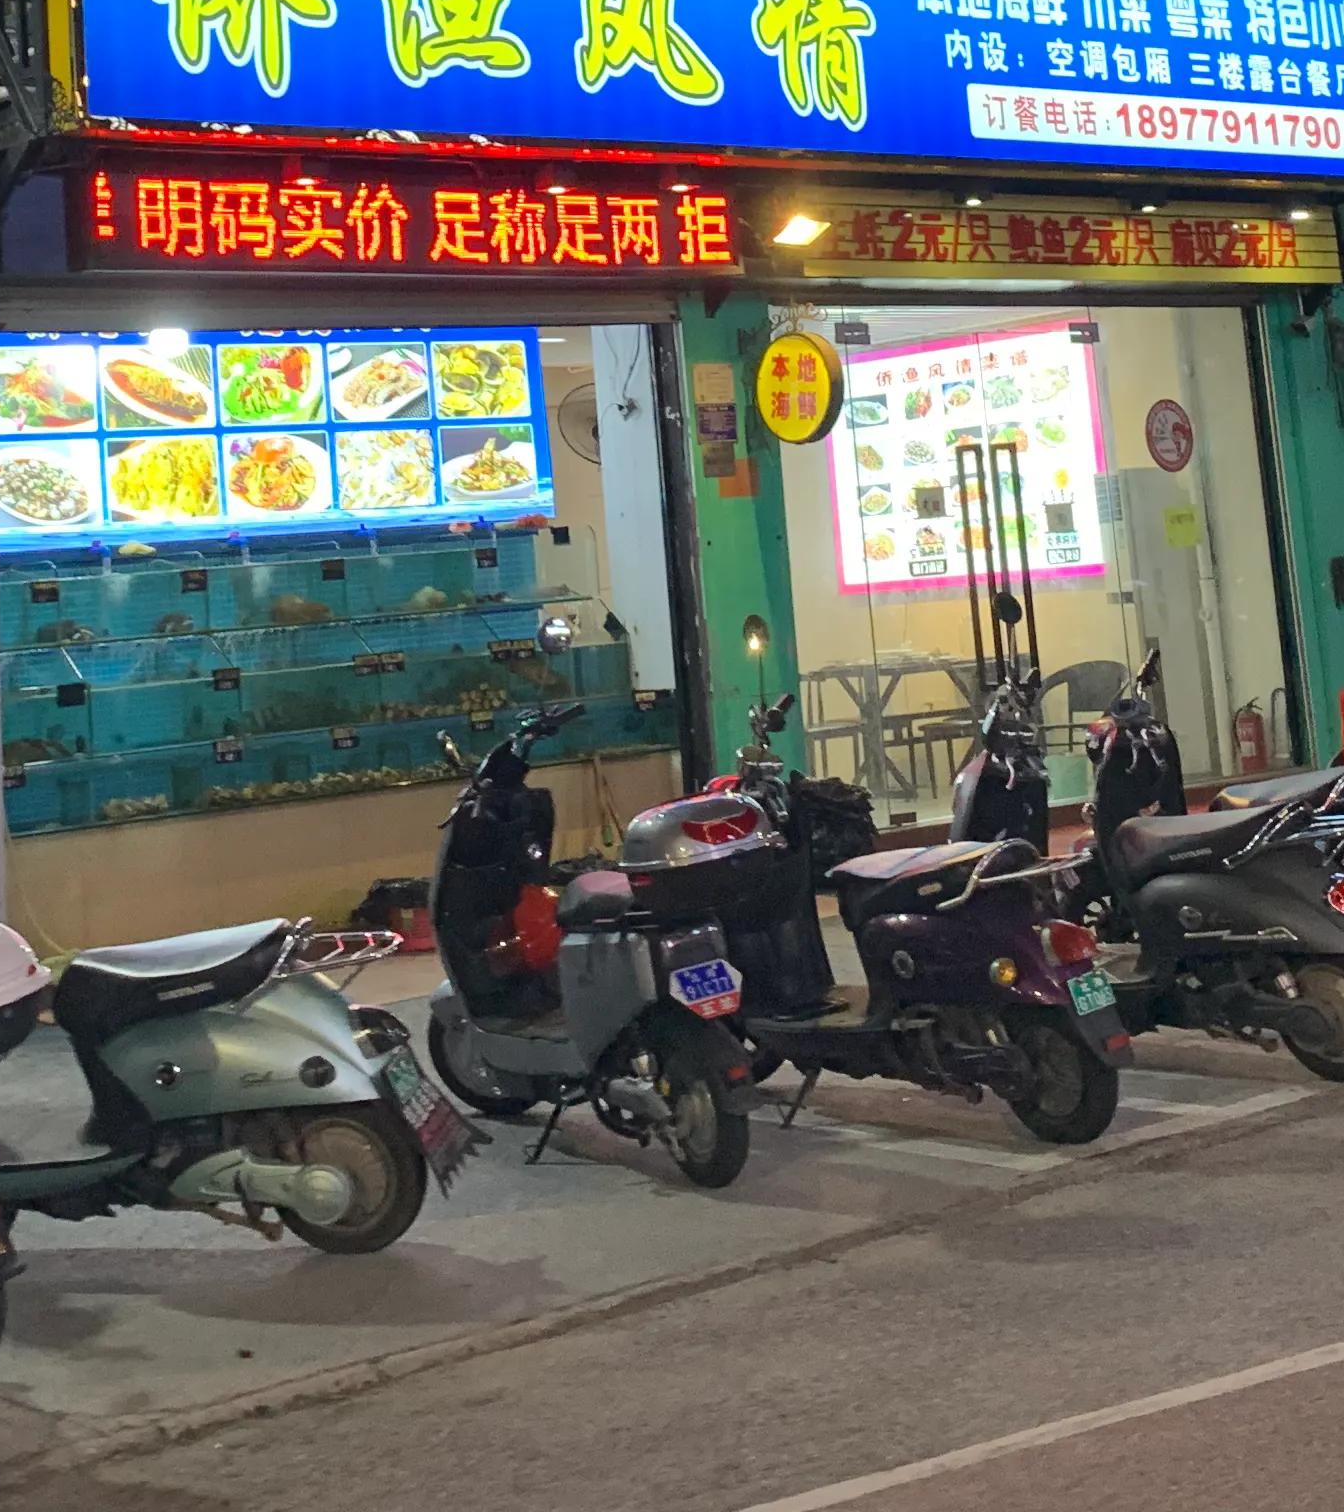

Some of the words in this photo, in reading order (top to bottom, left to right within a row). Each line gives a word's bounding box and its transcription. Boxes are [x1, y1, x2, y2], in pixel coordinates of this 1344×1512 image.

[137, 178, 409, 263] 明码实价
[430, 188, 660, 264] 足称足两
[676, 194, 732, 264] 拒
[771, 352, 817, 383] 本地
[876, 349, 1029, 388] 侨渔风情菜谱
[771, 390, 817, 421] 海鲜
